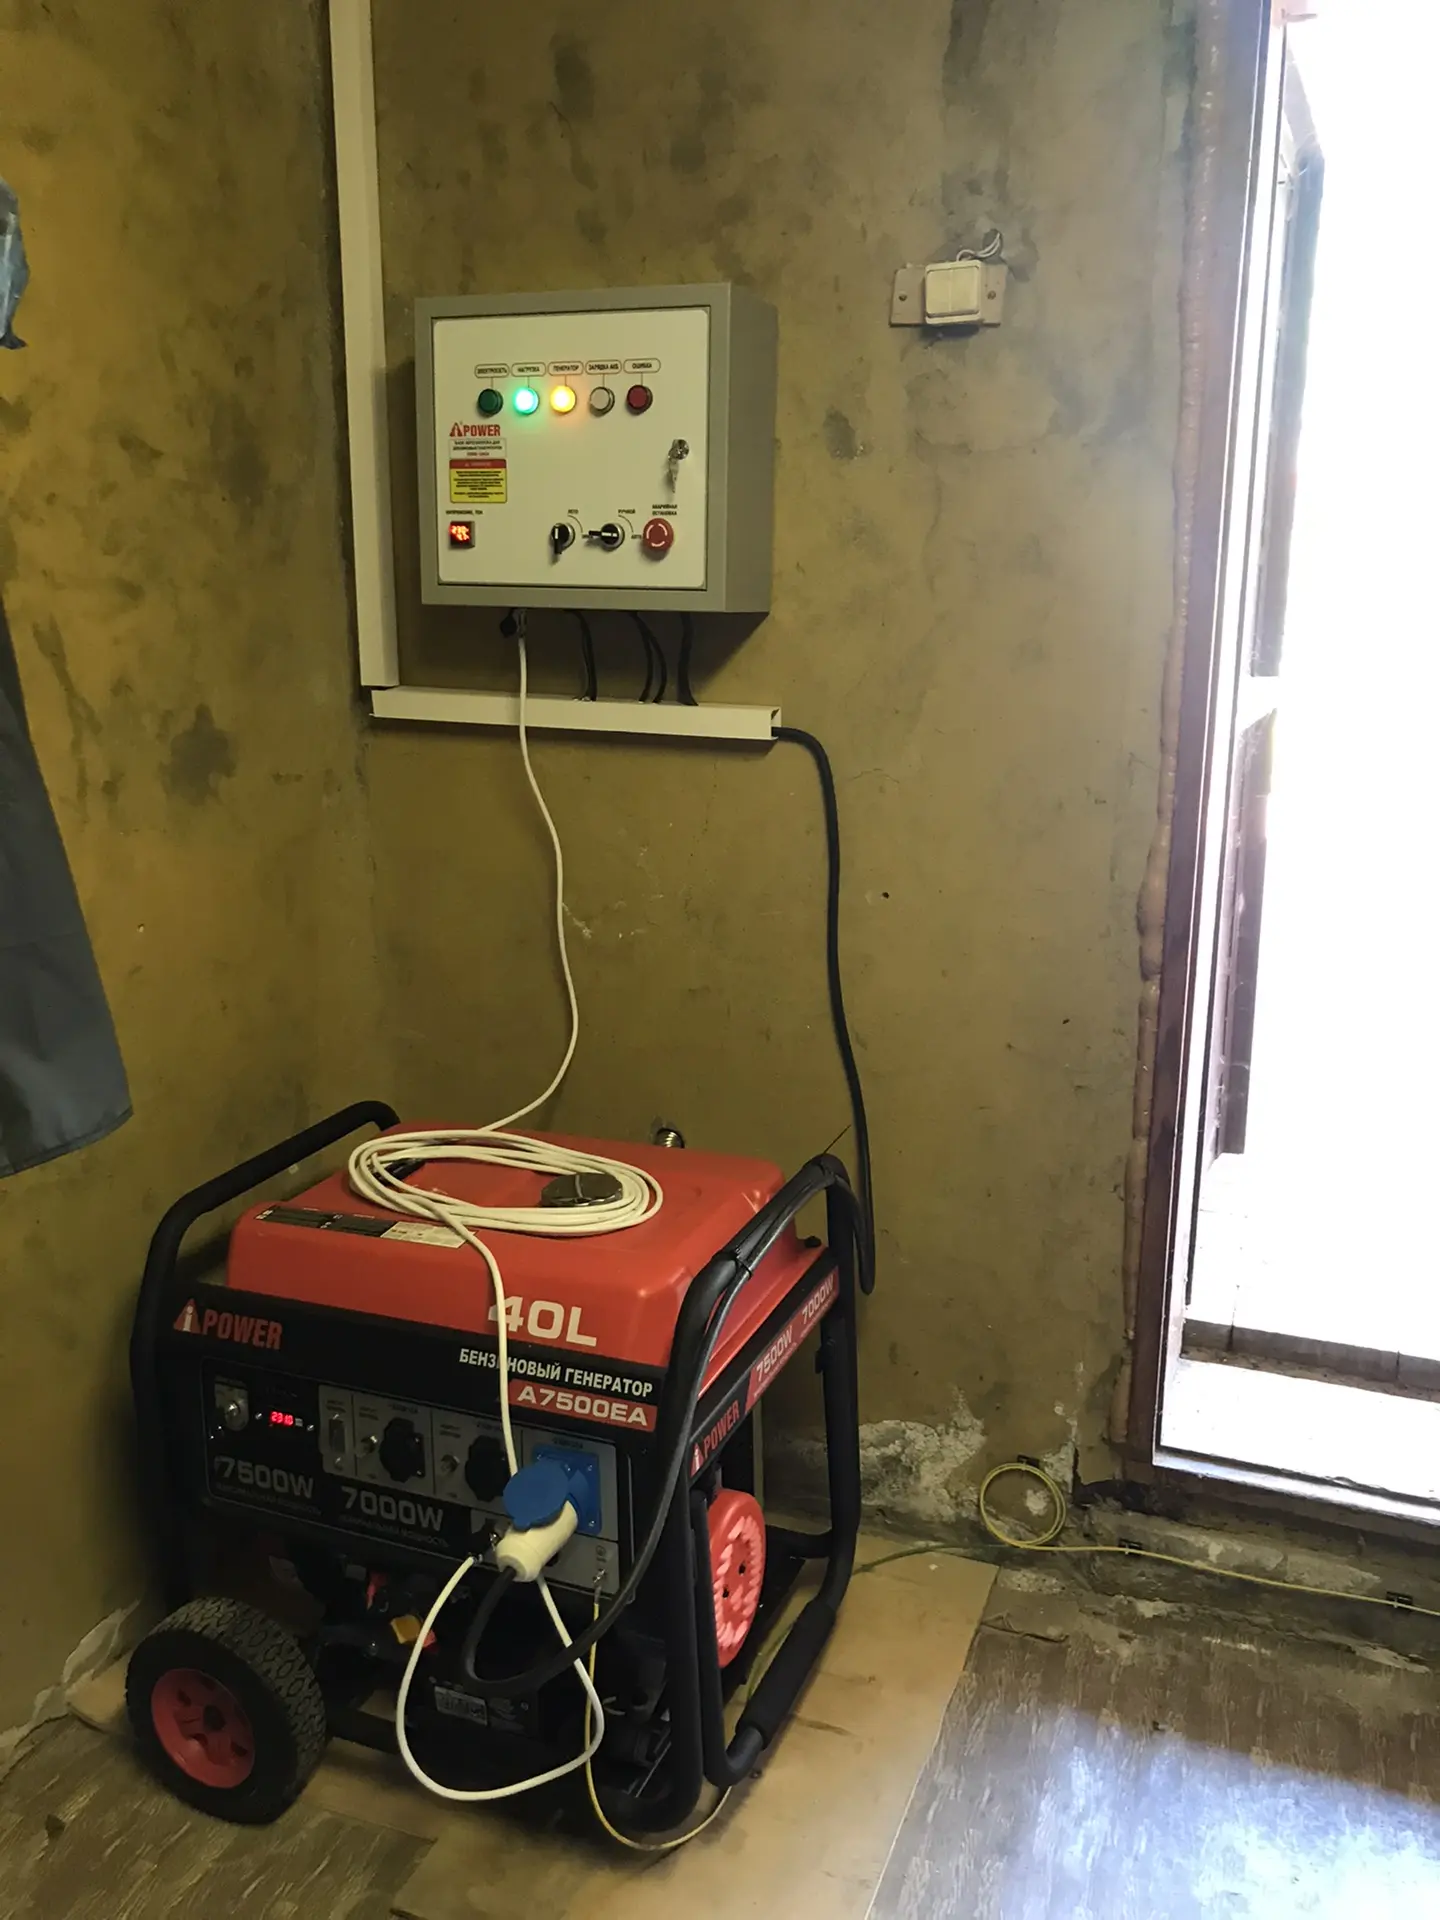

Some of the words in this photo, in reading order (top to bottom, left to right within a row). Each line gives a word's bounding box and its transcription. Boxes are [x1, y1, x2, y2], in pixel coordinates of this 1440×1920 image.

[488, 1296, 597, 1347] 40L
[756, 1325, 793, 1382] 7500W
[801, 1274, 834, 1325] 7000W
[459, 1348, 561, 1381] БЕНЗНОВЫЙ
[564, 1367, 653, 1397] ГЕНЕРАТОР
[517, 1385, 648, 1427] A7500EA
[213, 1455, 314, 1499] 7500W
[340, 1485, 444, 1531] 7000W
